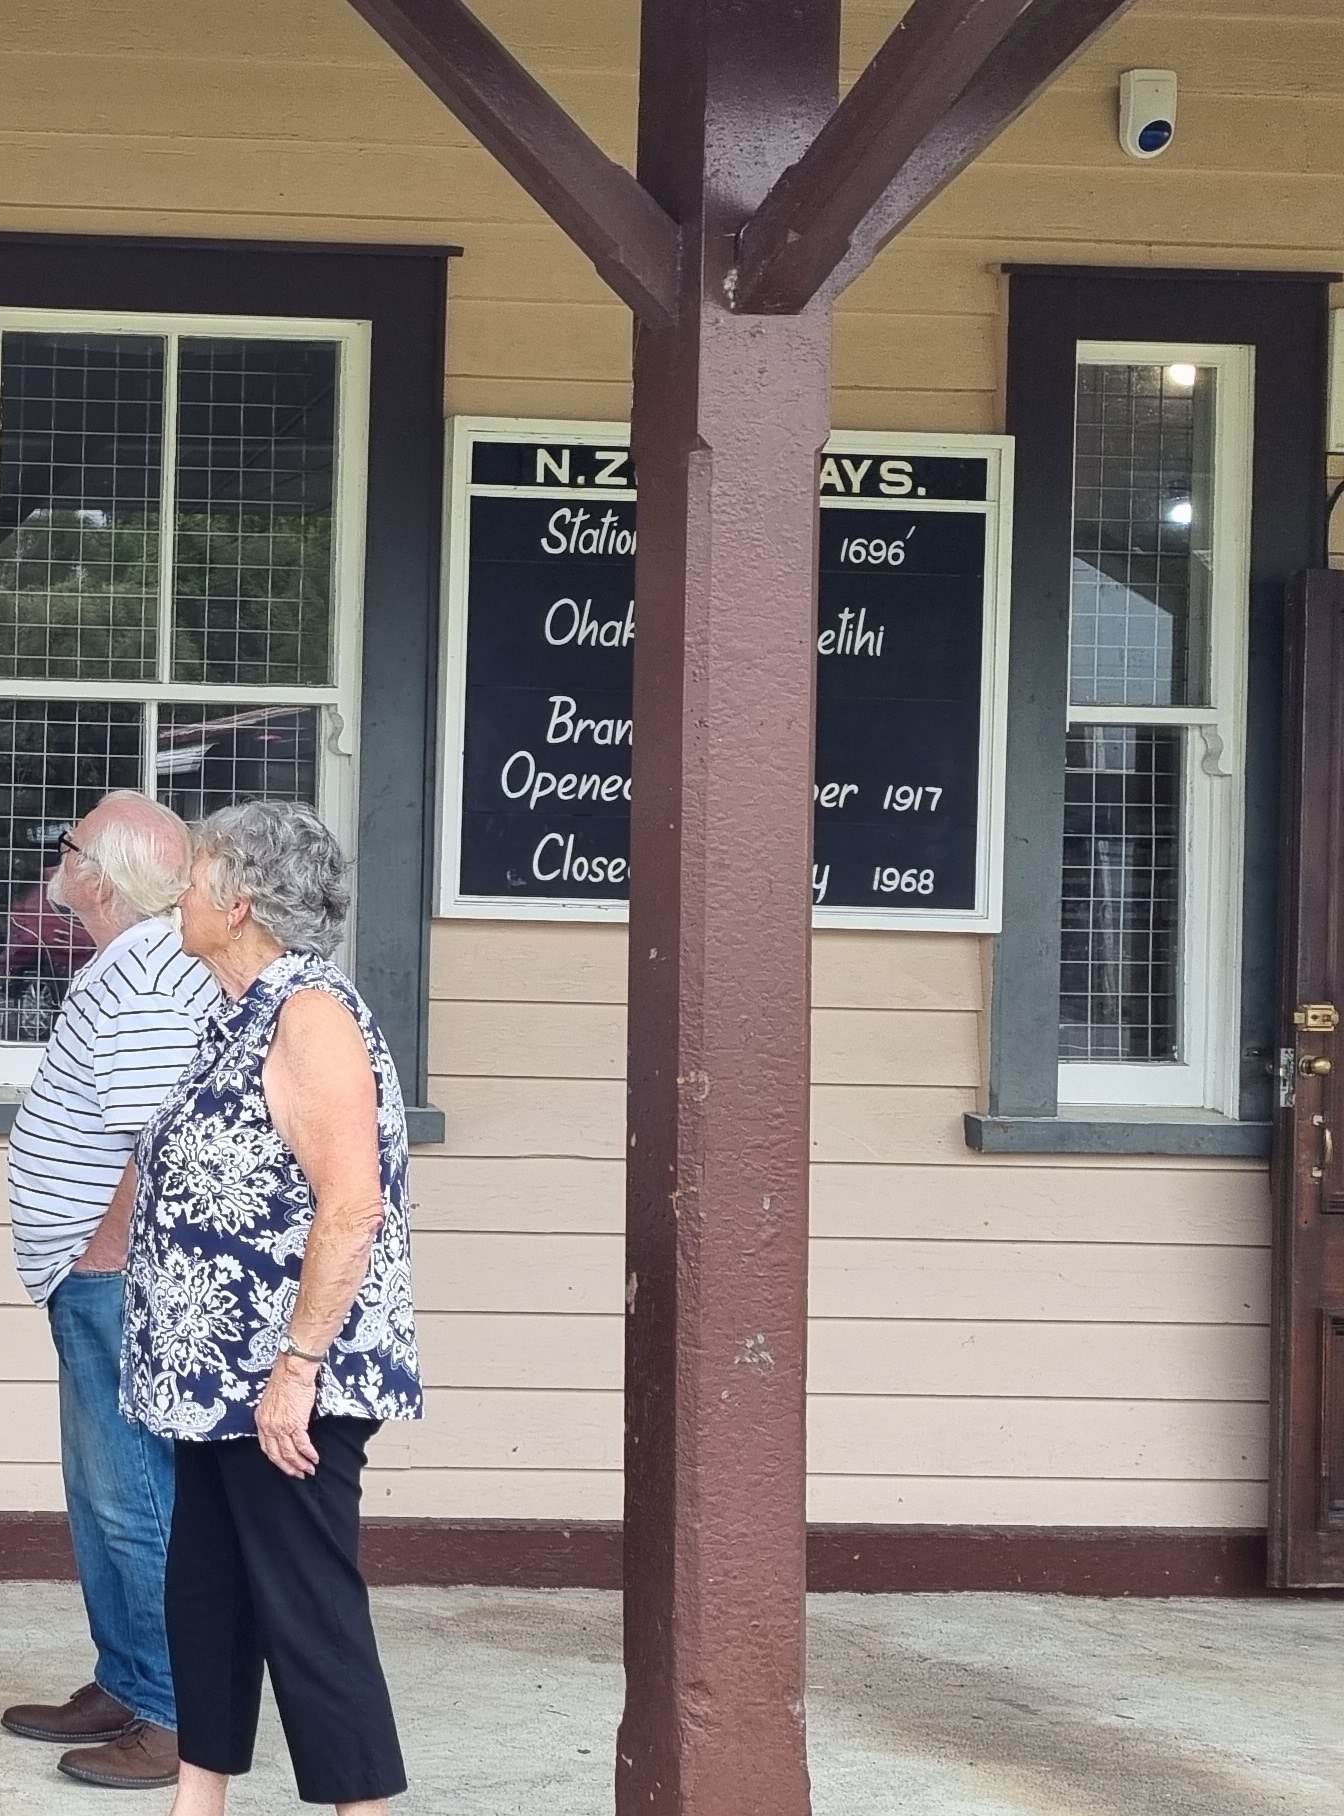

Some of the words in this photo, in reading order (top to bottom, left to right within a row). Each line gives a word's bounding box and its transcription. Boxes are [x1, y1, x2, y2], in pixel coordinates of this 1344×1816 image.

[883, 784, 943, 812] 1917
[532, 832, 631, 883] Close
[872, 866, 935, 895] 1968
